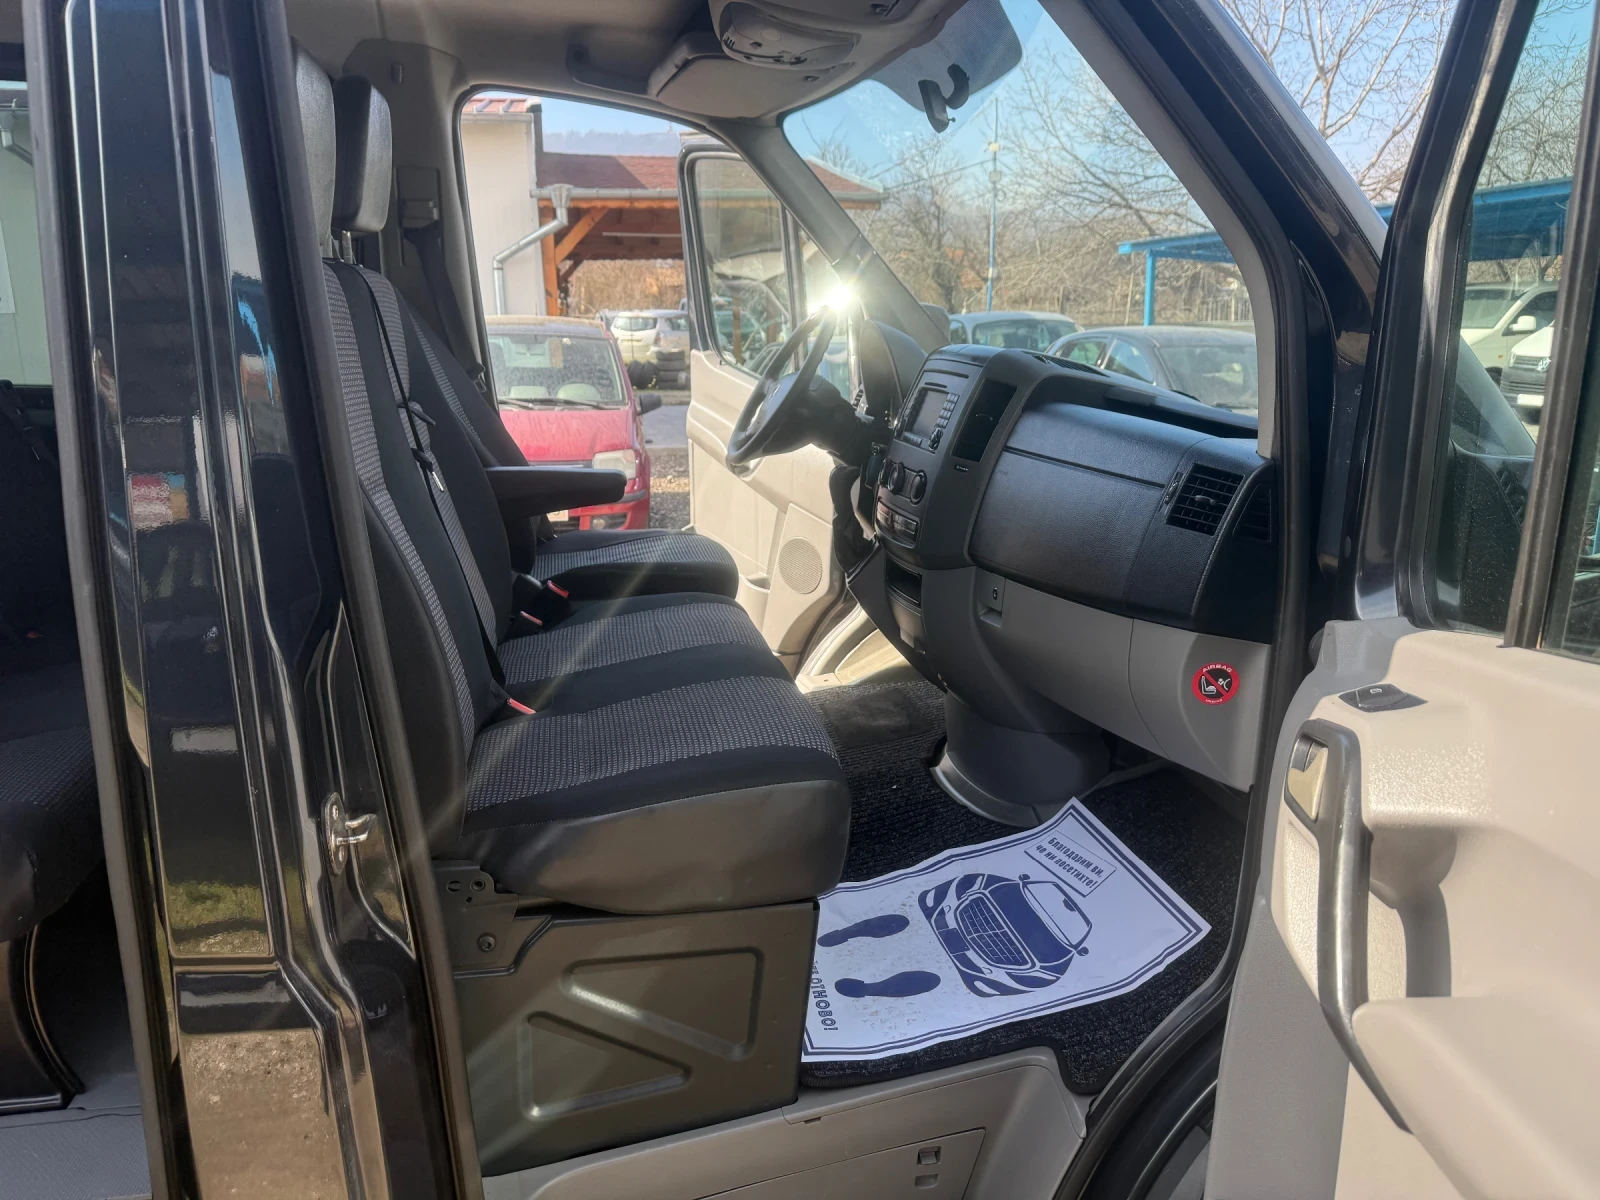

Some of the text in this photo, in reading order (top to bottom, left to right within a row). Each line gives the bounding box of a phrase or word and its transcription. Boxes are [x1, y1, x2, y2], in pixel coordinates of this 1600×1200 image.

[1202, 664, 1233, 673] AIRBAG
[1036, 844, 1098, 889] че ни посетихте!
[1047, 837, 1093, 870] Благодарим
